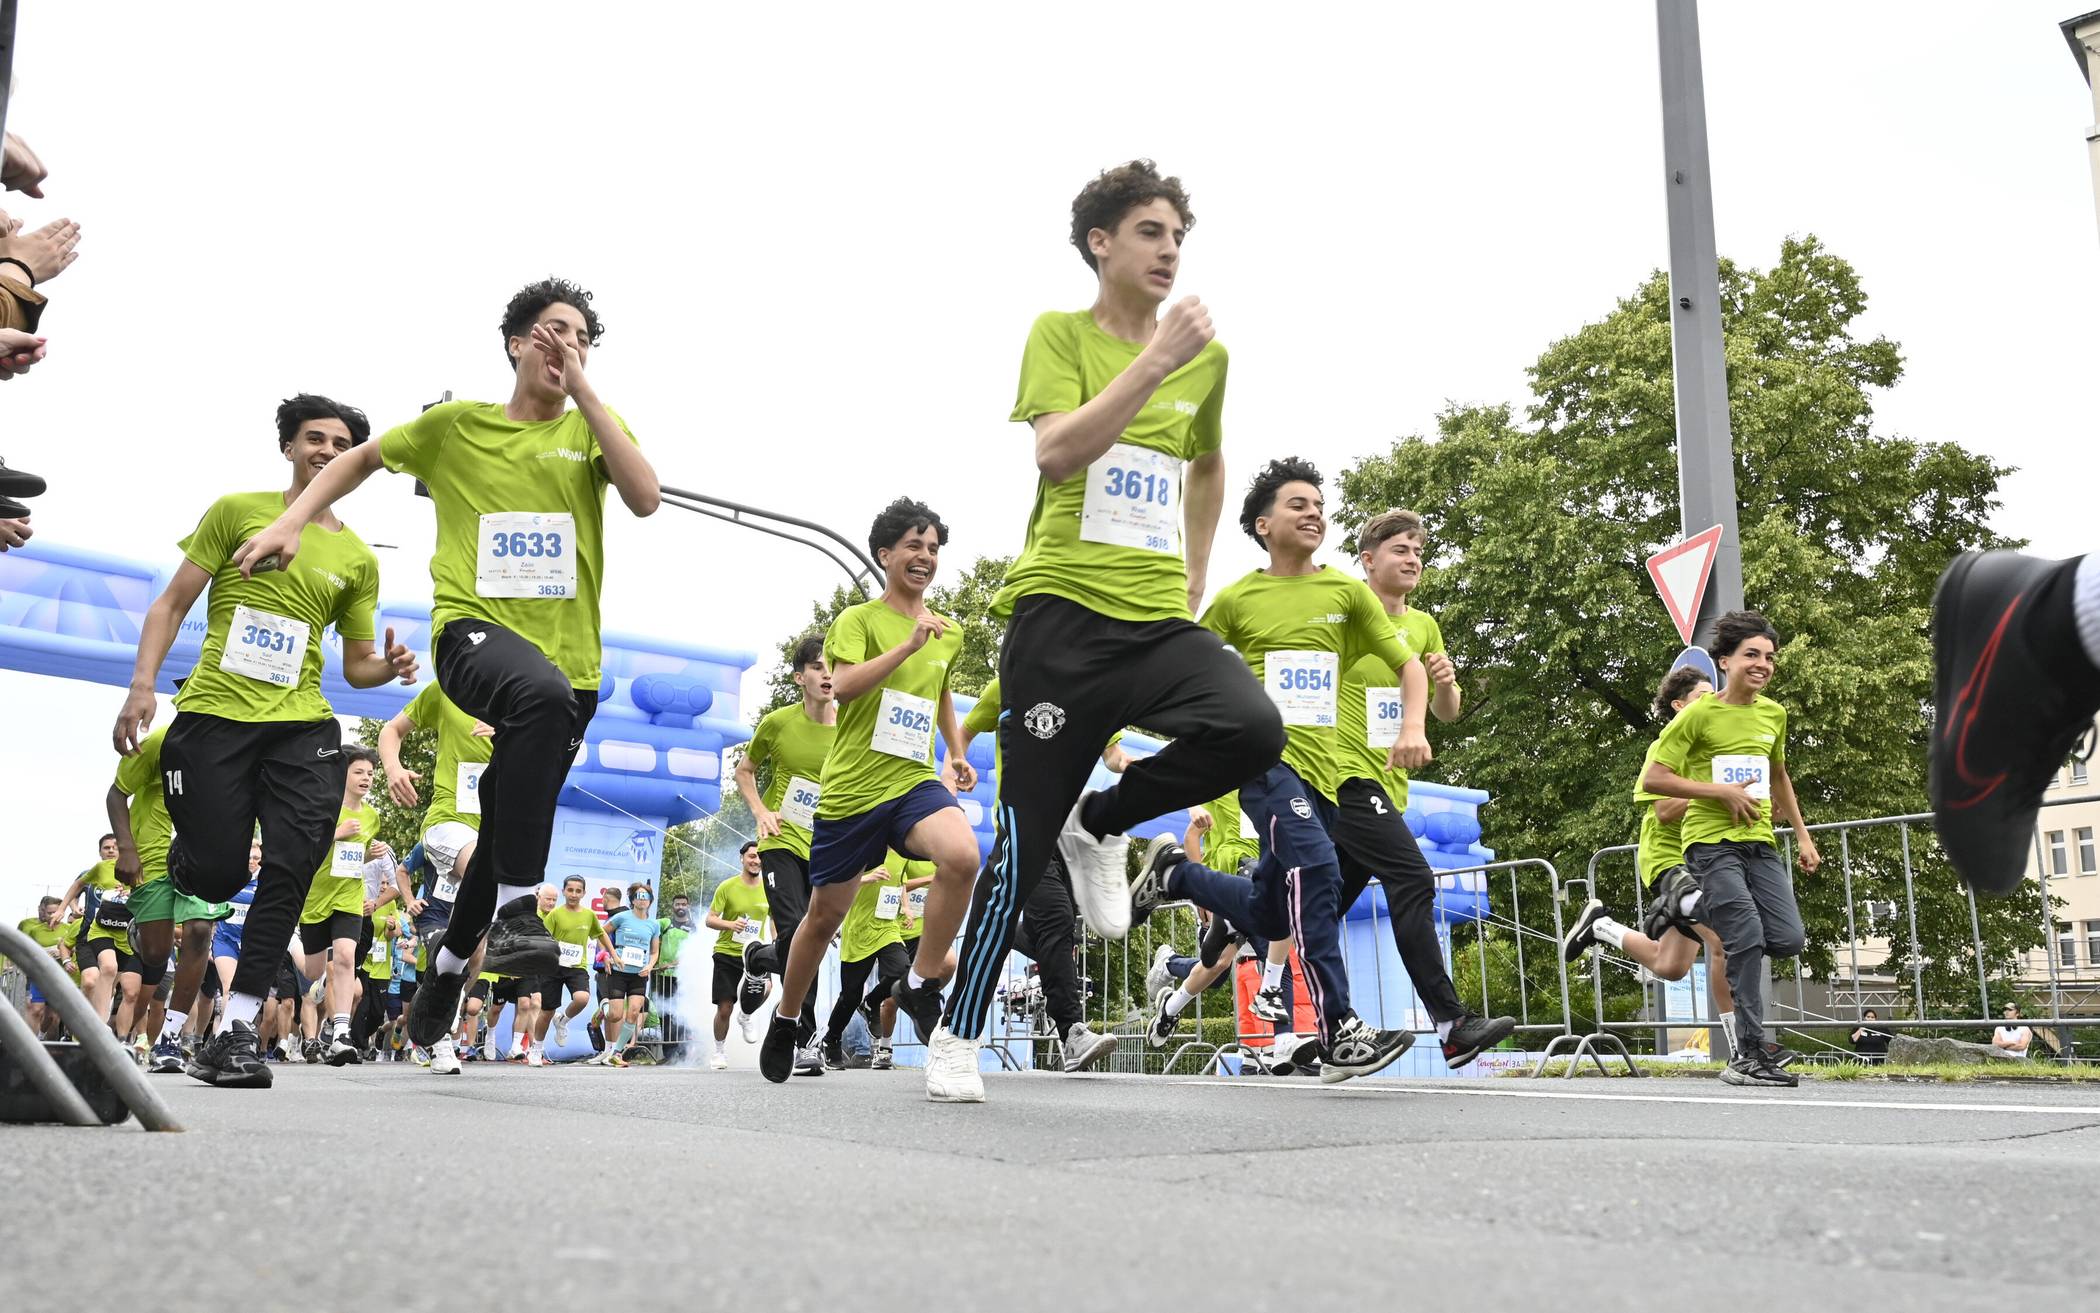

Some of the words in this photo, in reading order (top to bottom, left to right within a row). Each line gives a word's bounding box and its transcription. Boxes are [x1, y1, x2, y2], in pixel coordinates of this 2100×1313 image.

[1104, 467, 1169, 506] 3618
[492, 532, 562, 558] 3633
[1146, 535, 1169, 550] 3618
[538, 584, 566, 595] 3633
[242, 624, 296, 655] 3631
[269, 672, 290, 684] 3631
[1279, 668, 1332, 691] 3654
[889, 706, 931, 733] 3625
[1316, 714, 1332, 724] 3654
[1378, 702, 1404, 720] 361
[166, 770, 183, 795] 14
[1723, 767, 1762, 784] 3653
[793, 789, 820, 809] 362
[1369, 796, 1388, 815] 2
[340, 850, 363, 862] 3639
[235, 908, 247, 918] 30
[745, 925, 759, 935] 656
